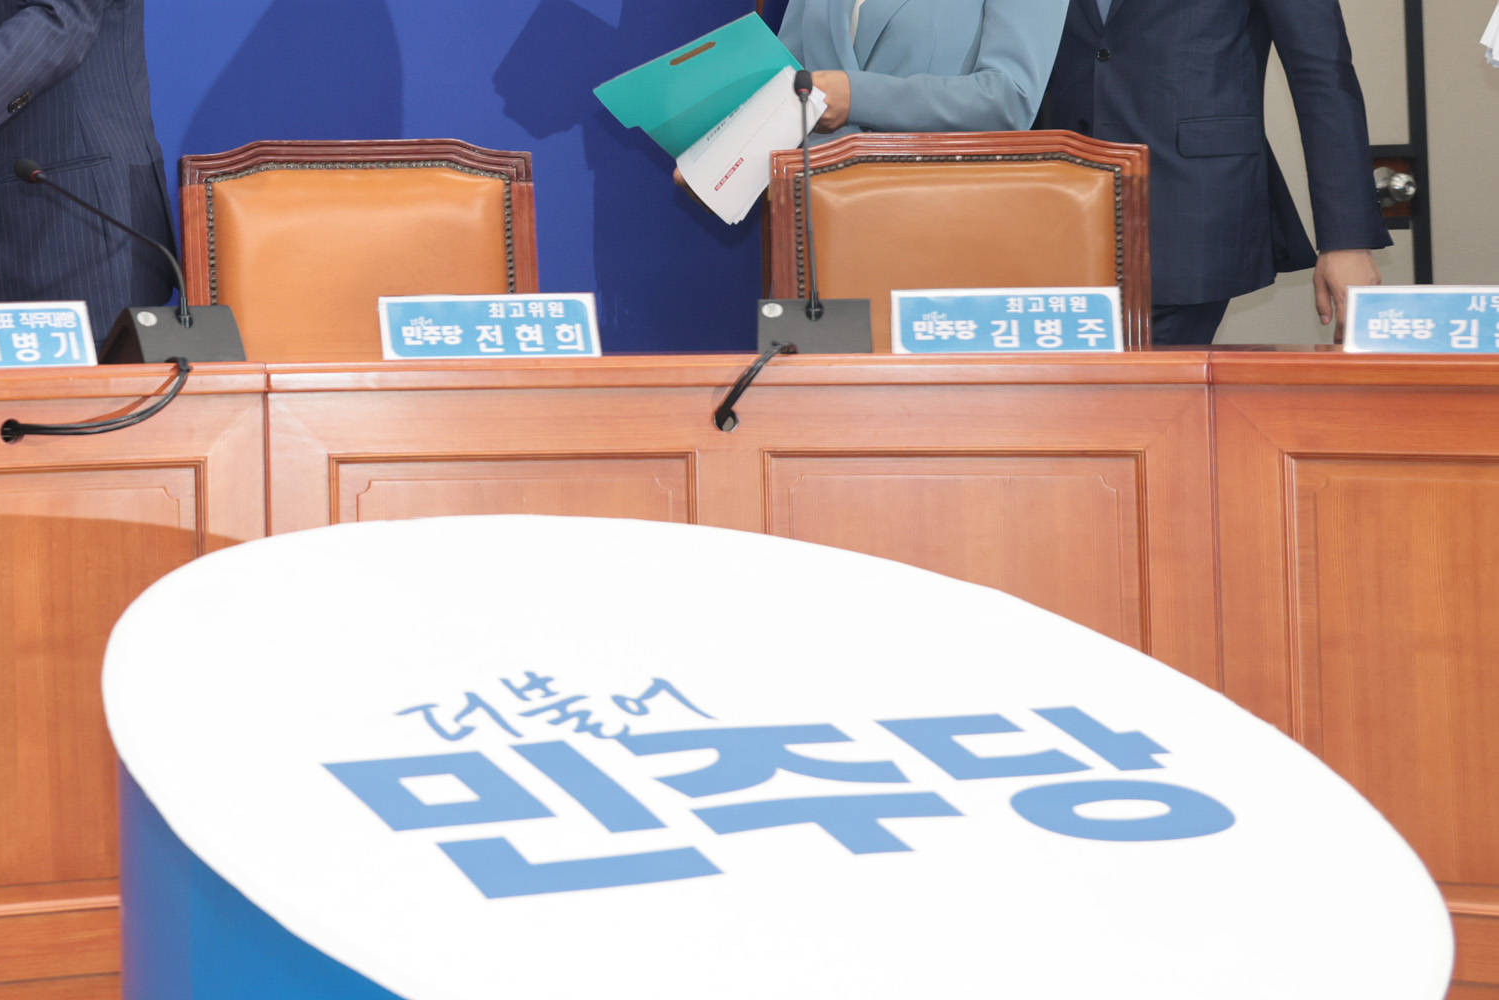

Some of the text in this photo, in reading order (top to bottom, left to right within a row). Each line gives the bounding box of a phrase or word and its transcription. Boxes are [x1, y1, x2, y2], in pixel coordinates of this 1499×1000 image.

[488, 301, 566, 319] 최고위원
[1005, 296, 1088, 313] 최고위원
[19, 311, 78, 329] 직무대행
[912, 320, 978, 341] 민주당
[1367, 318, 1436, 340] 민주당
[401, 325, 464, 346] 민주당
[475, 323, 586, 353] 전현희
[990, 318, 1108, 349] 김병주
[395, 670, 718, 742] 더불어
[320, 704, 1237, 900] 민주당
